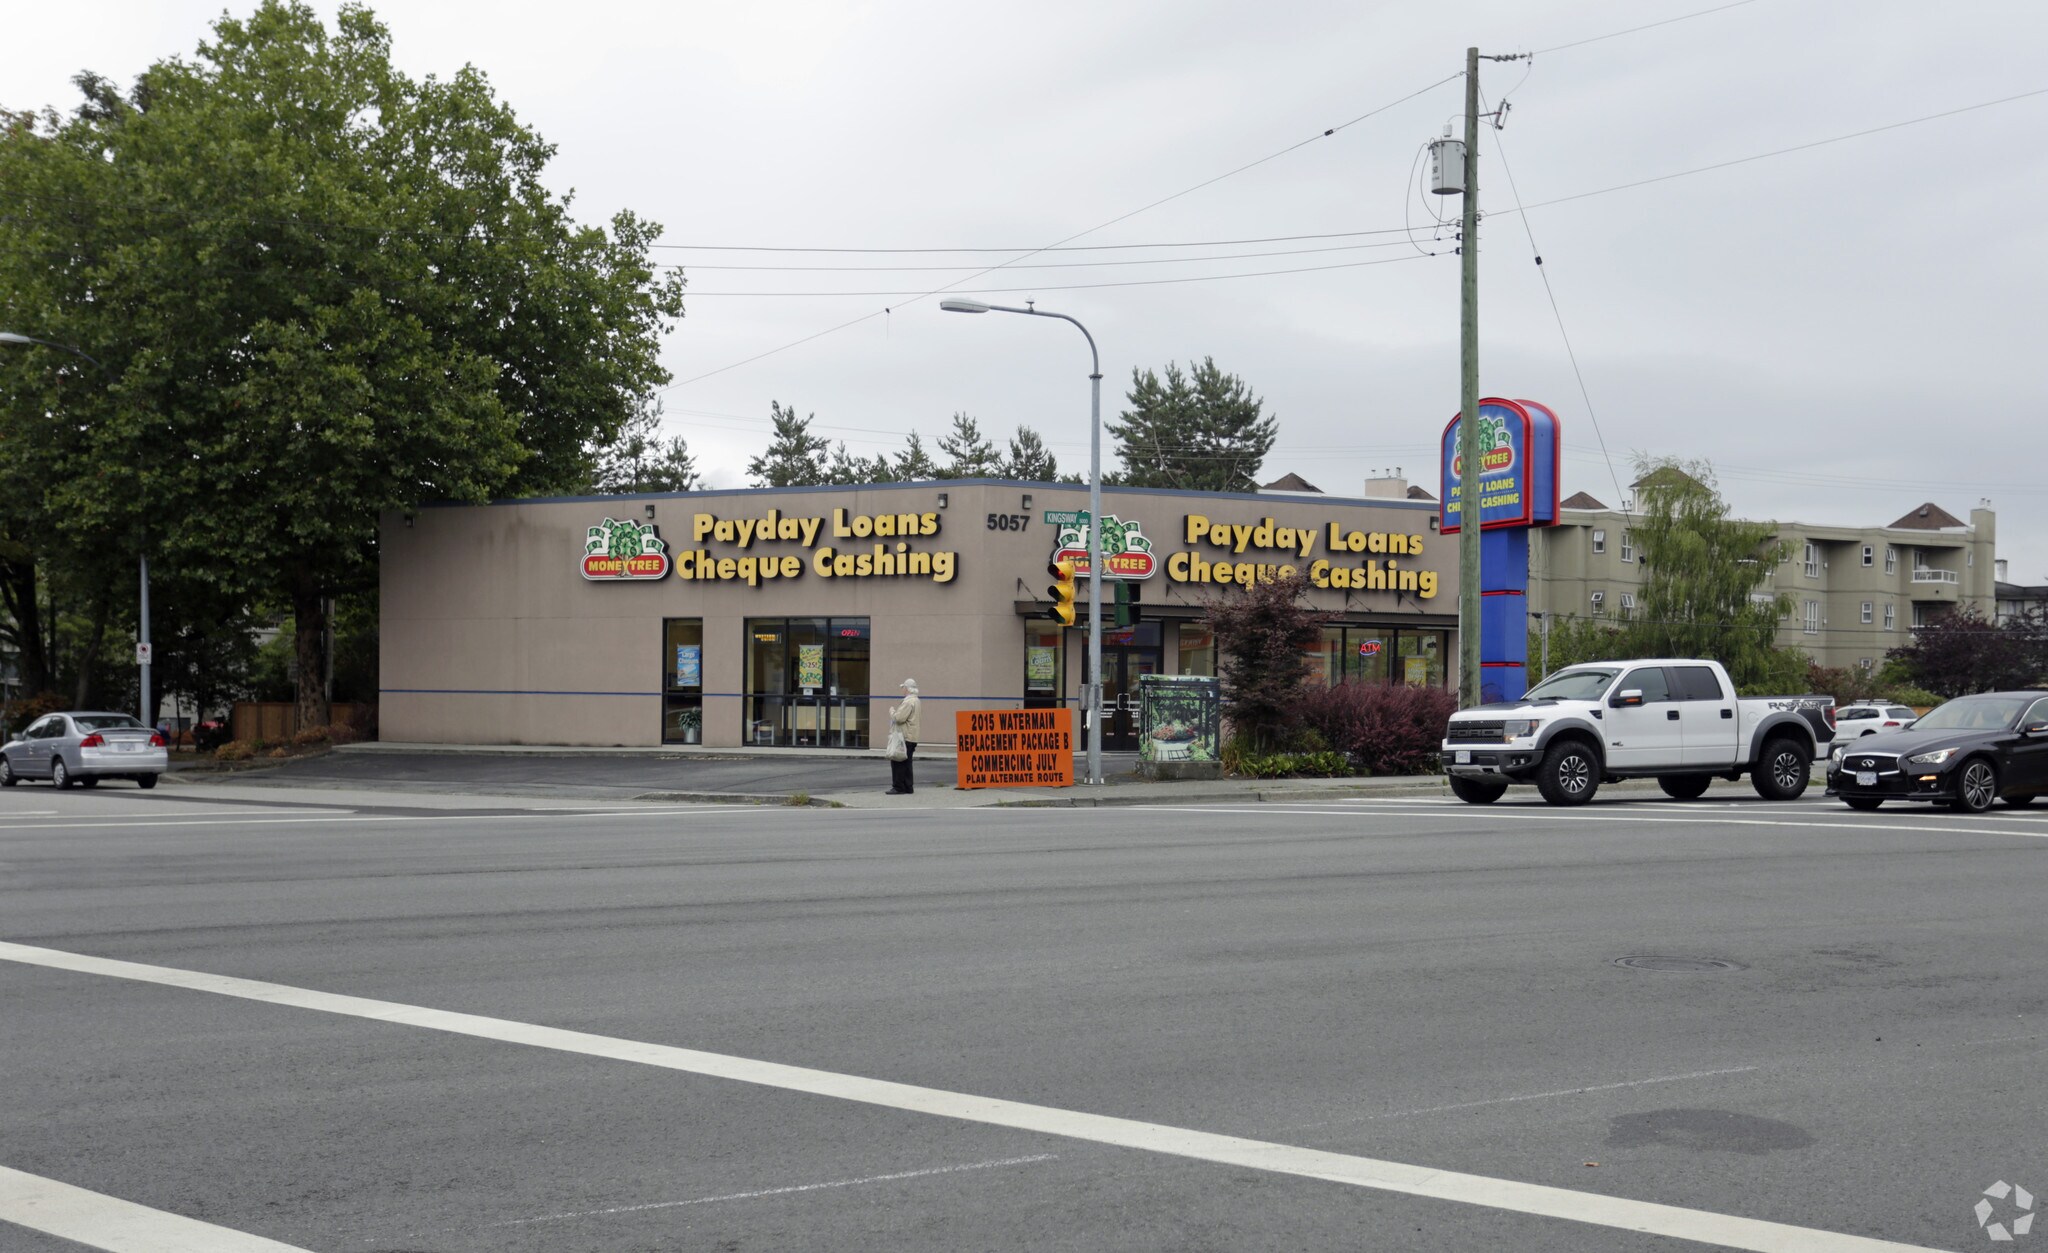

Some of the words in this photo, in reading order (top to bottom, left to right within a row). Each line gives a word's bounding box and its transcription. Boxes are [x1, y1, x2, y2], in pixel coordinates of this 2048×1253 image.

[1486, 478, 1514, 492] LOANS
[1482, 494, 1519, 508] CASHING
[693, 510, 821, 548] Payday
[833, 508, 938, 538] Loans
[987, 513, 1031, 532] 5057
[1047, 513, 1078, 524] KINGSWAY
[1187, 515, 1317, 557] Payday
[1329, 522, 1424, 556] Loans
[676, 549, 801, 586] Cheque
[813, 542, 955, 583] Cashing
[1310, 559, 1438, 599] Cashing
[1360, 643, 1381, 652] ATM
[1768, 702, 1822, 711] RAPTOR
[971, 713, 994, 731] 2015
[999, 712, 1055, 731] WATERMAIN
[958, 733, 1018, 752] REPLACEMENT
[1021, 732, 1060, 750] PACKAGE
[1063, 732, 1069, 750] B
[971, 754, 1032, 773] COMMENCING
[1036, 753, 1057, 771] JULY
[966, 774, 986, 784] PLAN
[989, 773, 1033, 783] ALTERNATE
[1037, 772, 1064, 783] ROUTE
